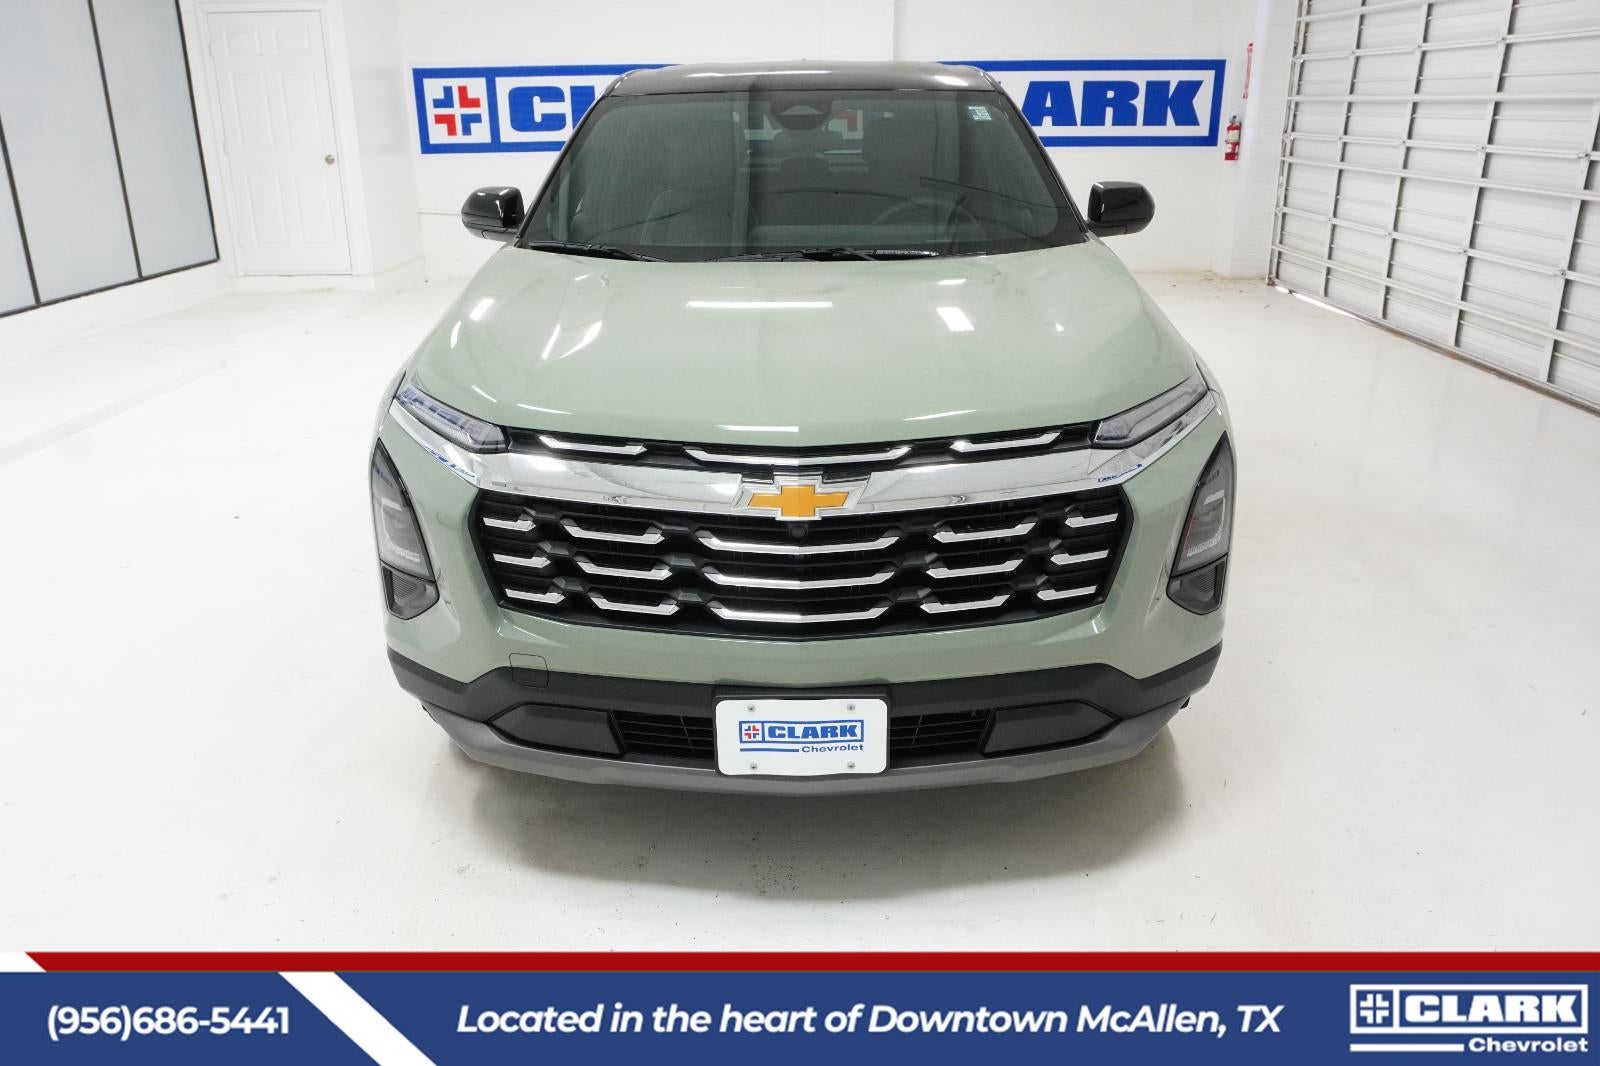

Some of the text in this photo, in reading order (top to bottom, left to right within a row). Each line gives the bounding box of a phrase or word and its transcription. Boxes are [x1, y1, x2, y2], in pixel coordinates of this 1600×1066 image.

[1020, 79, 1204, 127] ARK
[767, 725, 858, 739] CLARK
[801, 744, 864, 753] Chevrolet
